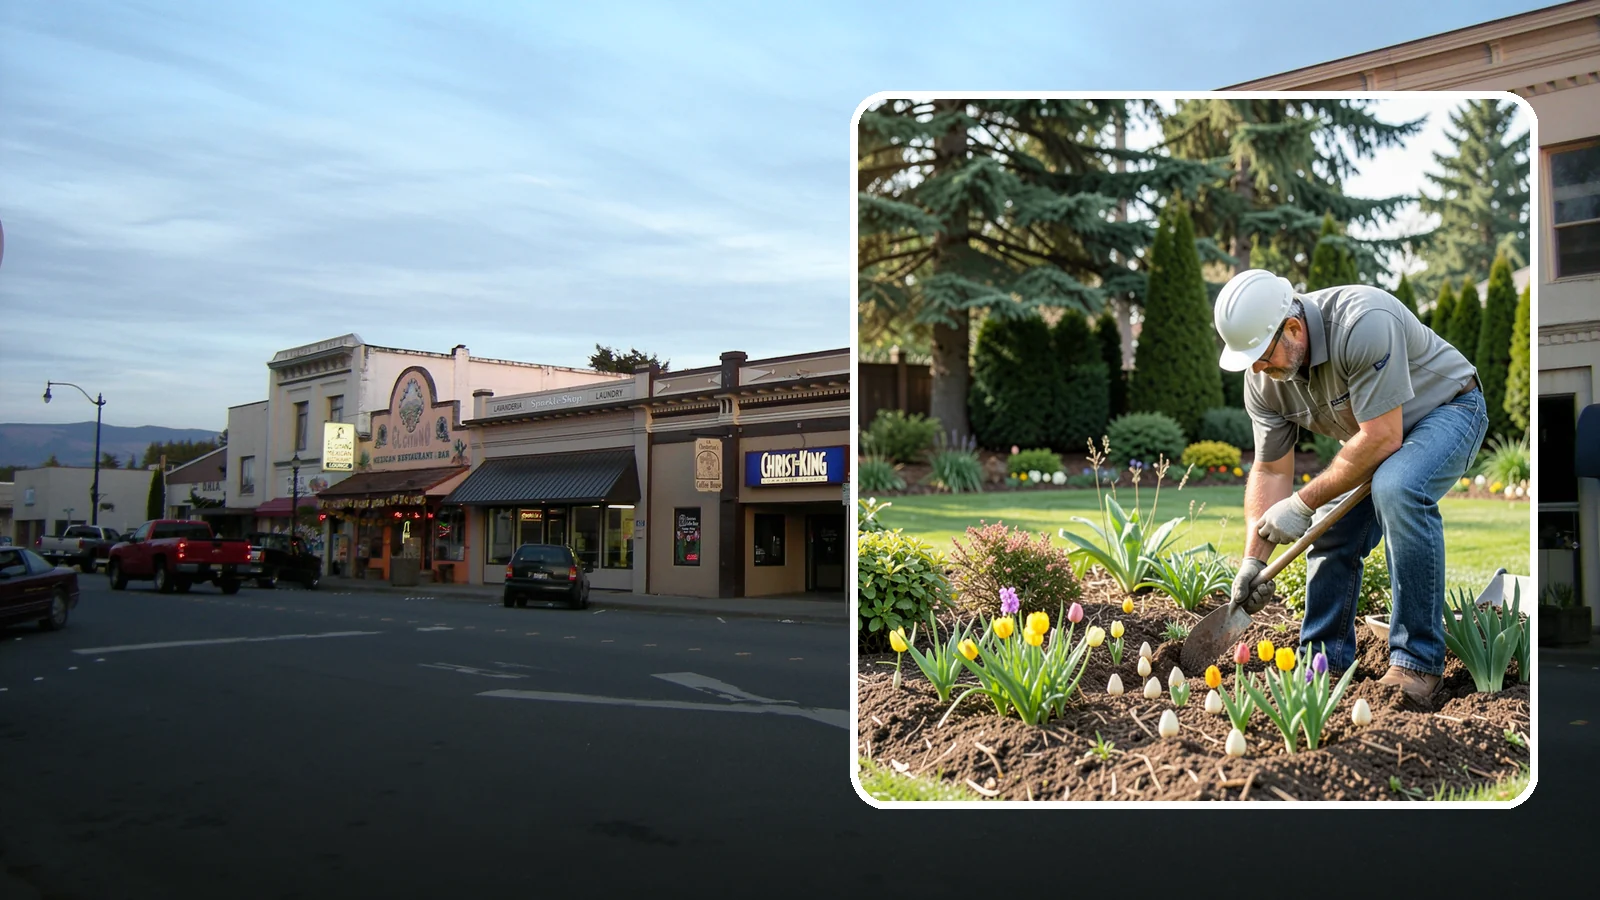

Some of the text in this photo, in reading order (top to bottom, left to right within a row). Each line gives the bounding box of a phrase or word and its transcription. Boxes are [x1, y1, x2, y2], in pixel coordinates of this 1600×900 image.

[562, 394, 583, 406] Shop
[595, 388, 624, 400] LAUNDRY
[493, 401, 522, 413] LAVANDERIA
[397, 452, 433, 461] RESTAURANT
[438, 451, 449, 459] BAR
[761, 450, 827, 478] CHRIST KING
